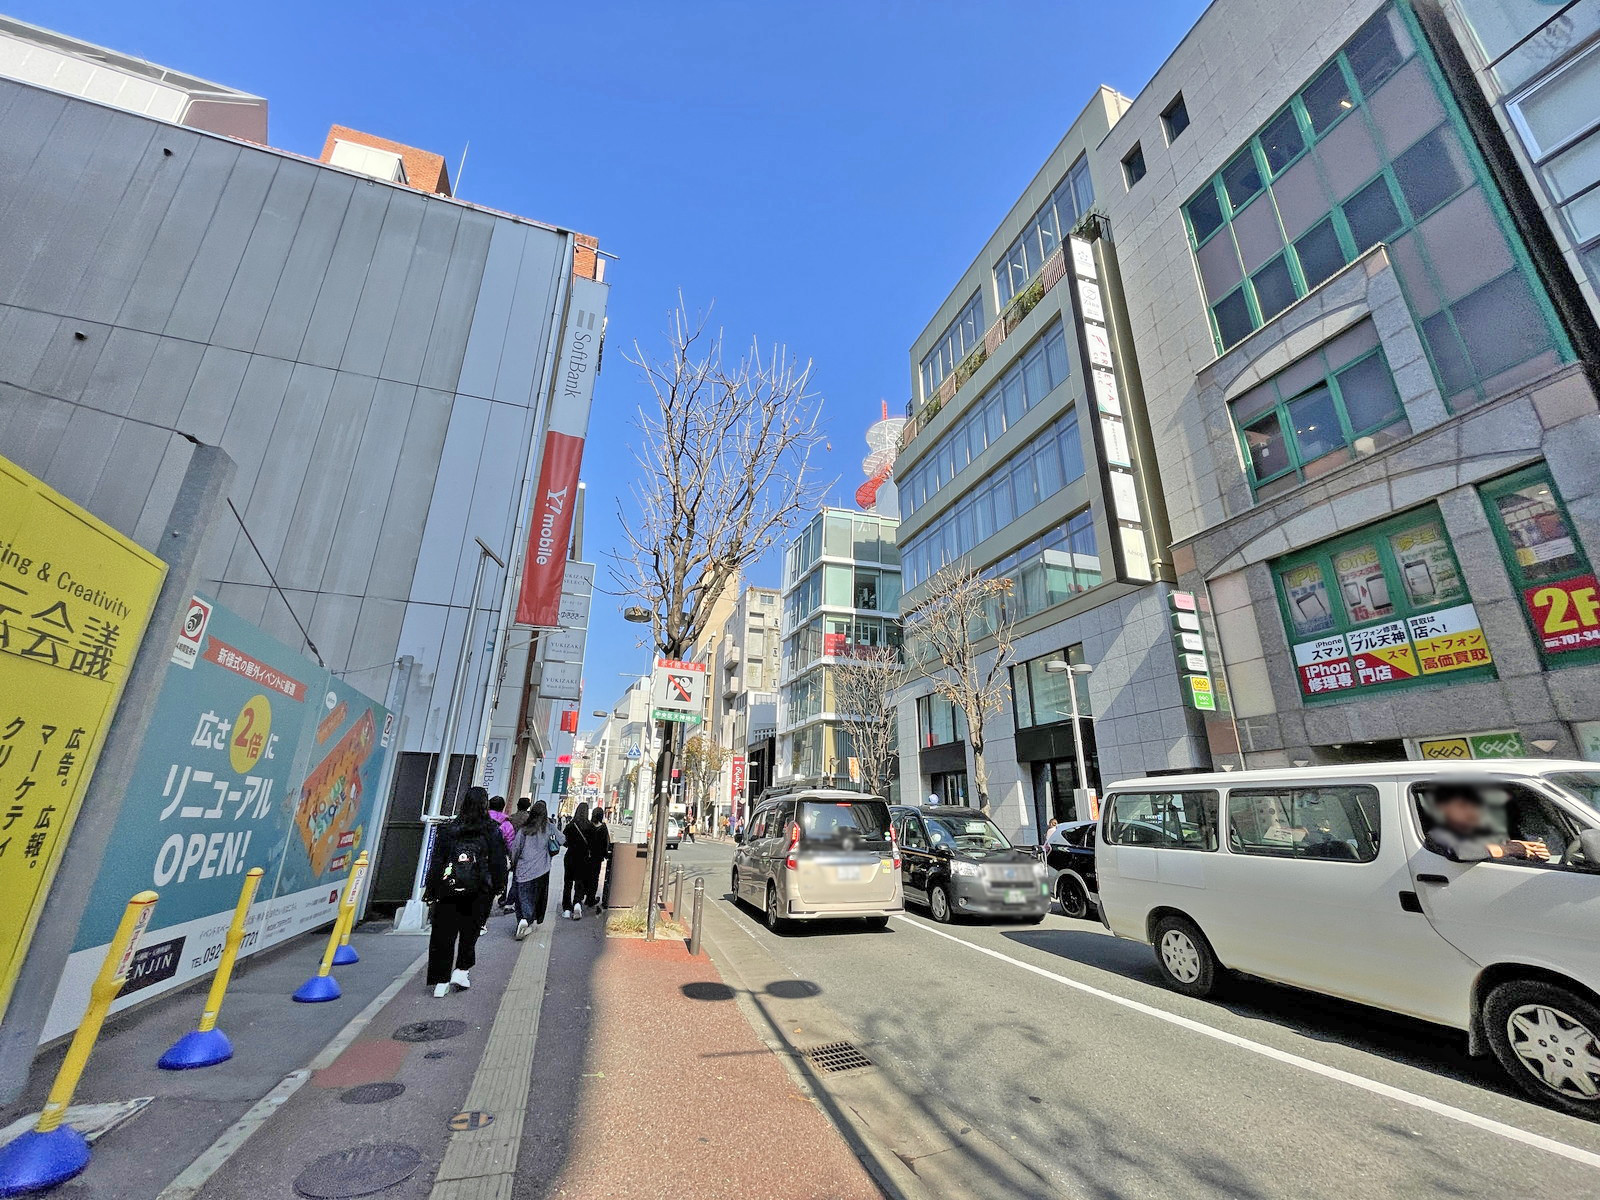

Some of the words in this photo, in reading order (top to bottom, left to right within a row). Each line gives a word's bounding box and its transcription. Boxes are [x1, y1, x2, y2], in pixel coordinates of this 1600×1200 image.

[564, 331, 592, 398] SoftBank
[0, 541, 33, 575] ing
[37, 561, 52, 583] &
[57, 571, 132, 621] Creativity
[1533, 586, 1600, 634] 2F
[1315, 638, 1342, 649] iPhone
[1422, 648, 1489, 671] 高価買取
[545, 677, 577, 685] YUKIZAKI
[1305, 658, 1366, 678] iPhone
[57, 727, 86, 787] 広告。
[483, 756, 498, 793] SoftBan
[160, 764, 273, 822] リニューアル
[24, 804, 56, 869] 広報。
[154, 830, 252, 887] OPEN!
[191, 957, 202, 969] TEL
